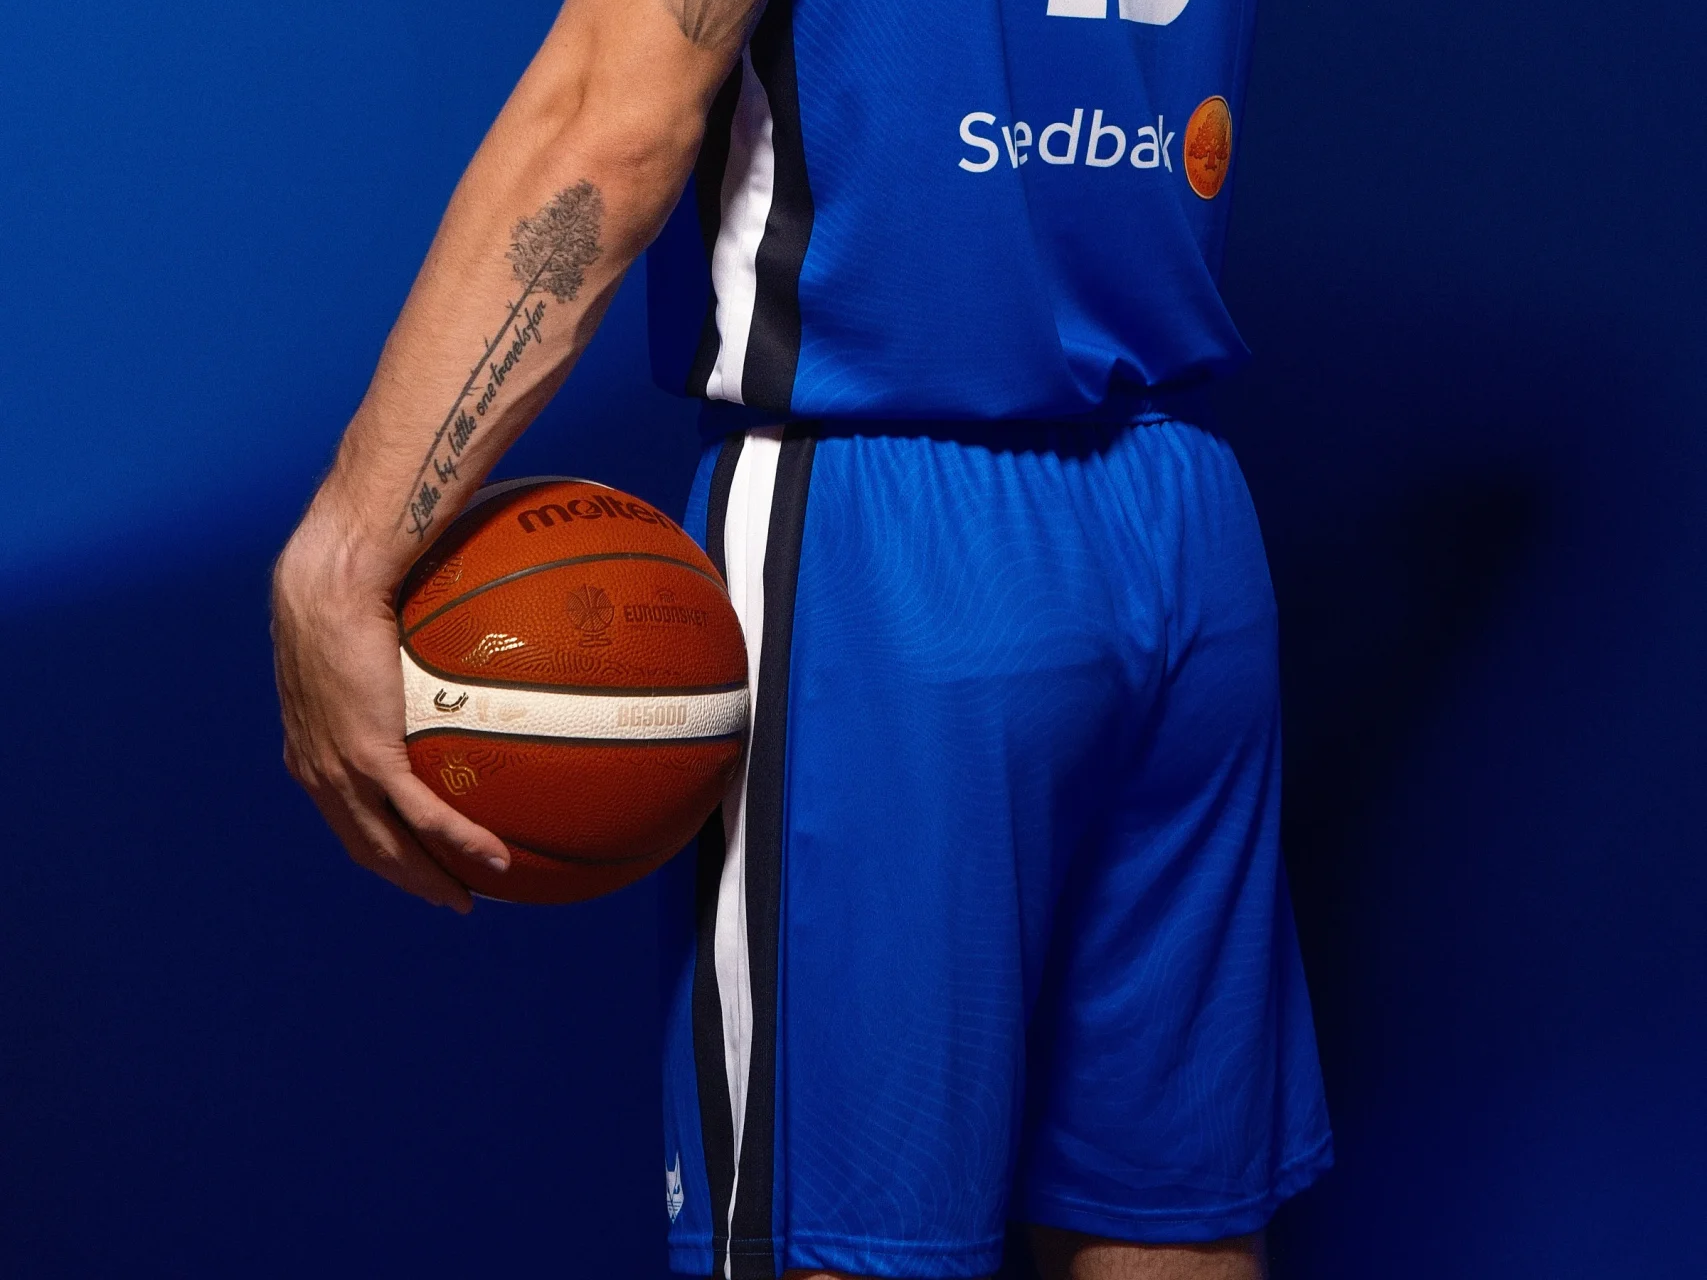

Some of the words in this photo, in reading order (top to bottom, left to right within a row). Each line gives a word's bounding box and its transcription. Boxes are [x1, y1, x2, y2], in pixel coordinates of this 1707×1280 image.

[406, 482, 441, 542] Little
[434, 455, 458, 484] by
[448, 409, 476, 457] little
[476, 382, 497, 416] one
[490, 324, 531, 387] travels
[524, 300, 546, 344] far
[517, 495, 682, 536] molten
[624, 605, 709, 628] EUROBASKET
[617, 704, 688, 728] BG5000
